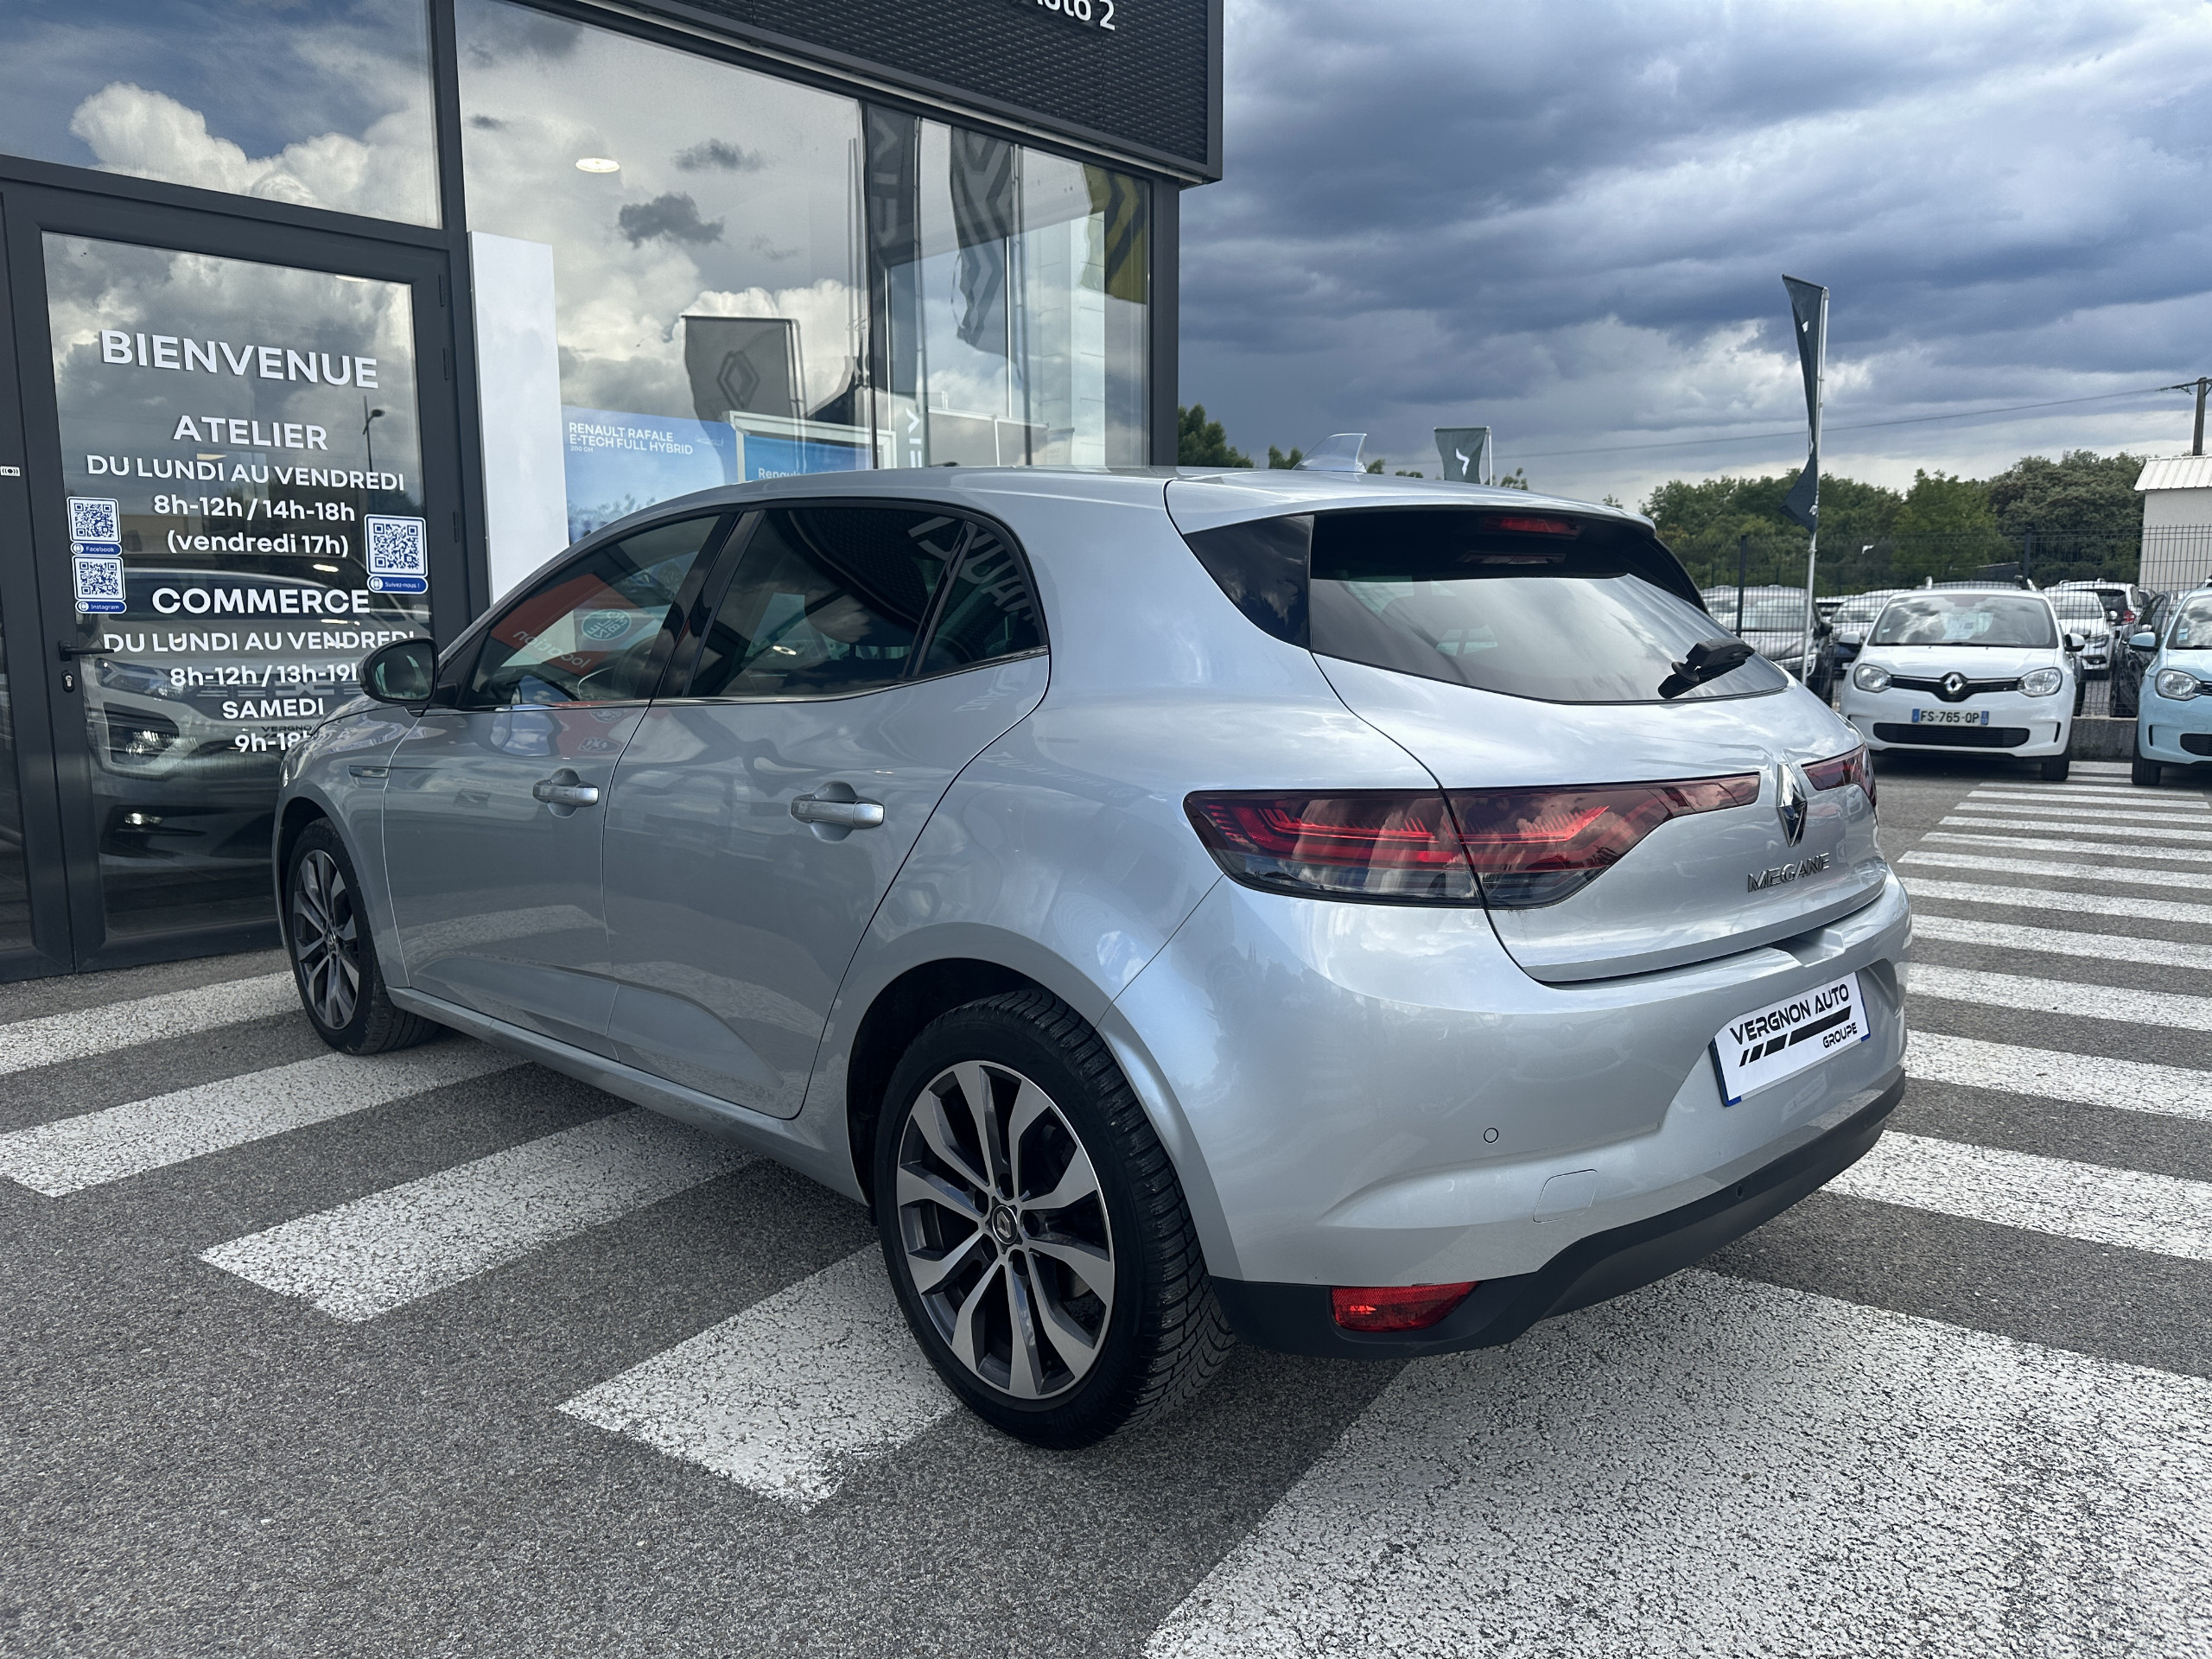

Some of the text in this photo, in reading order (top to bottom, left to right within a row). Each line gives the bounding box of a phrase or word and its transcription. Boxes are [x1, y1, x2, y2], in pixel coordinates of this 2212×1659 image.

[1037, 0, 1116, 31] uto 2
[101, 329, 378, 389] BIENVENUE
[174, 415, 327, 450] ATELIER
[569, 422, 674, 443] RENAULT RAFALE
[569, 434, 694, 455] E-TECH FULL HYBRID
[87, 454, 405, 492] DU LUNDI AU VENDREDI
[154, 494, 356, 523] 8h-12h / 14h-18h
[167, 530, 349, 559] (vendredi 17h)
[152, 588, 371, 614] COMMERCE
[104, 632, 145, 652] DU
[152, 632, 238, 652] LUNDI
[245, 631, 283, 651] AU
[169, 666, 257, 687] 8h-12h
[222, 697, 324, 719] SAMEDI
[234, 730, 311, 753] 9h-18
[1747, 853, 1830, 893] MEGANE
[1730, 983, 1850, 1046] VERGNON AUTO
[1822, 1021, 1858, 1049] GROUPE
